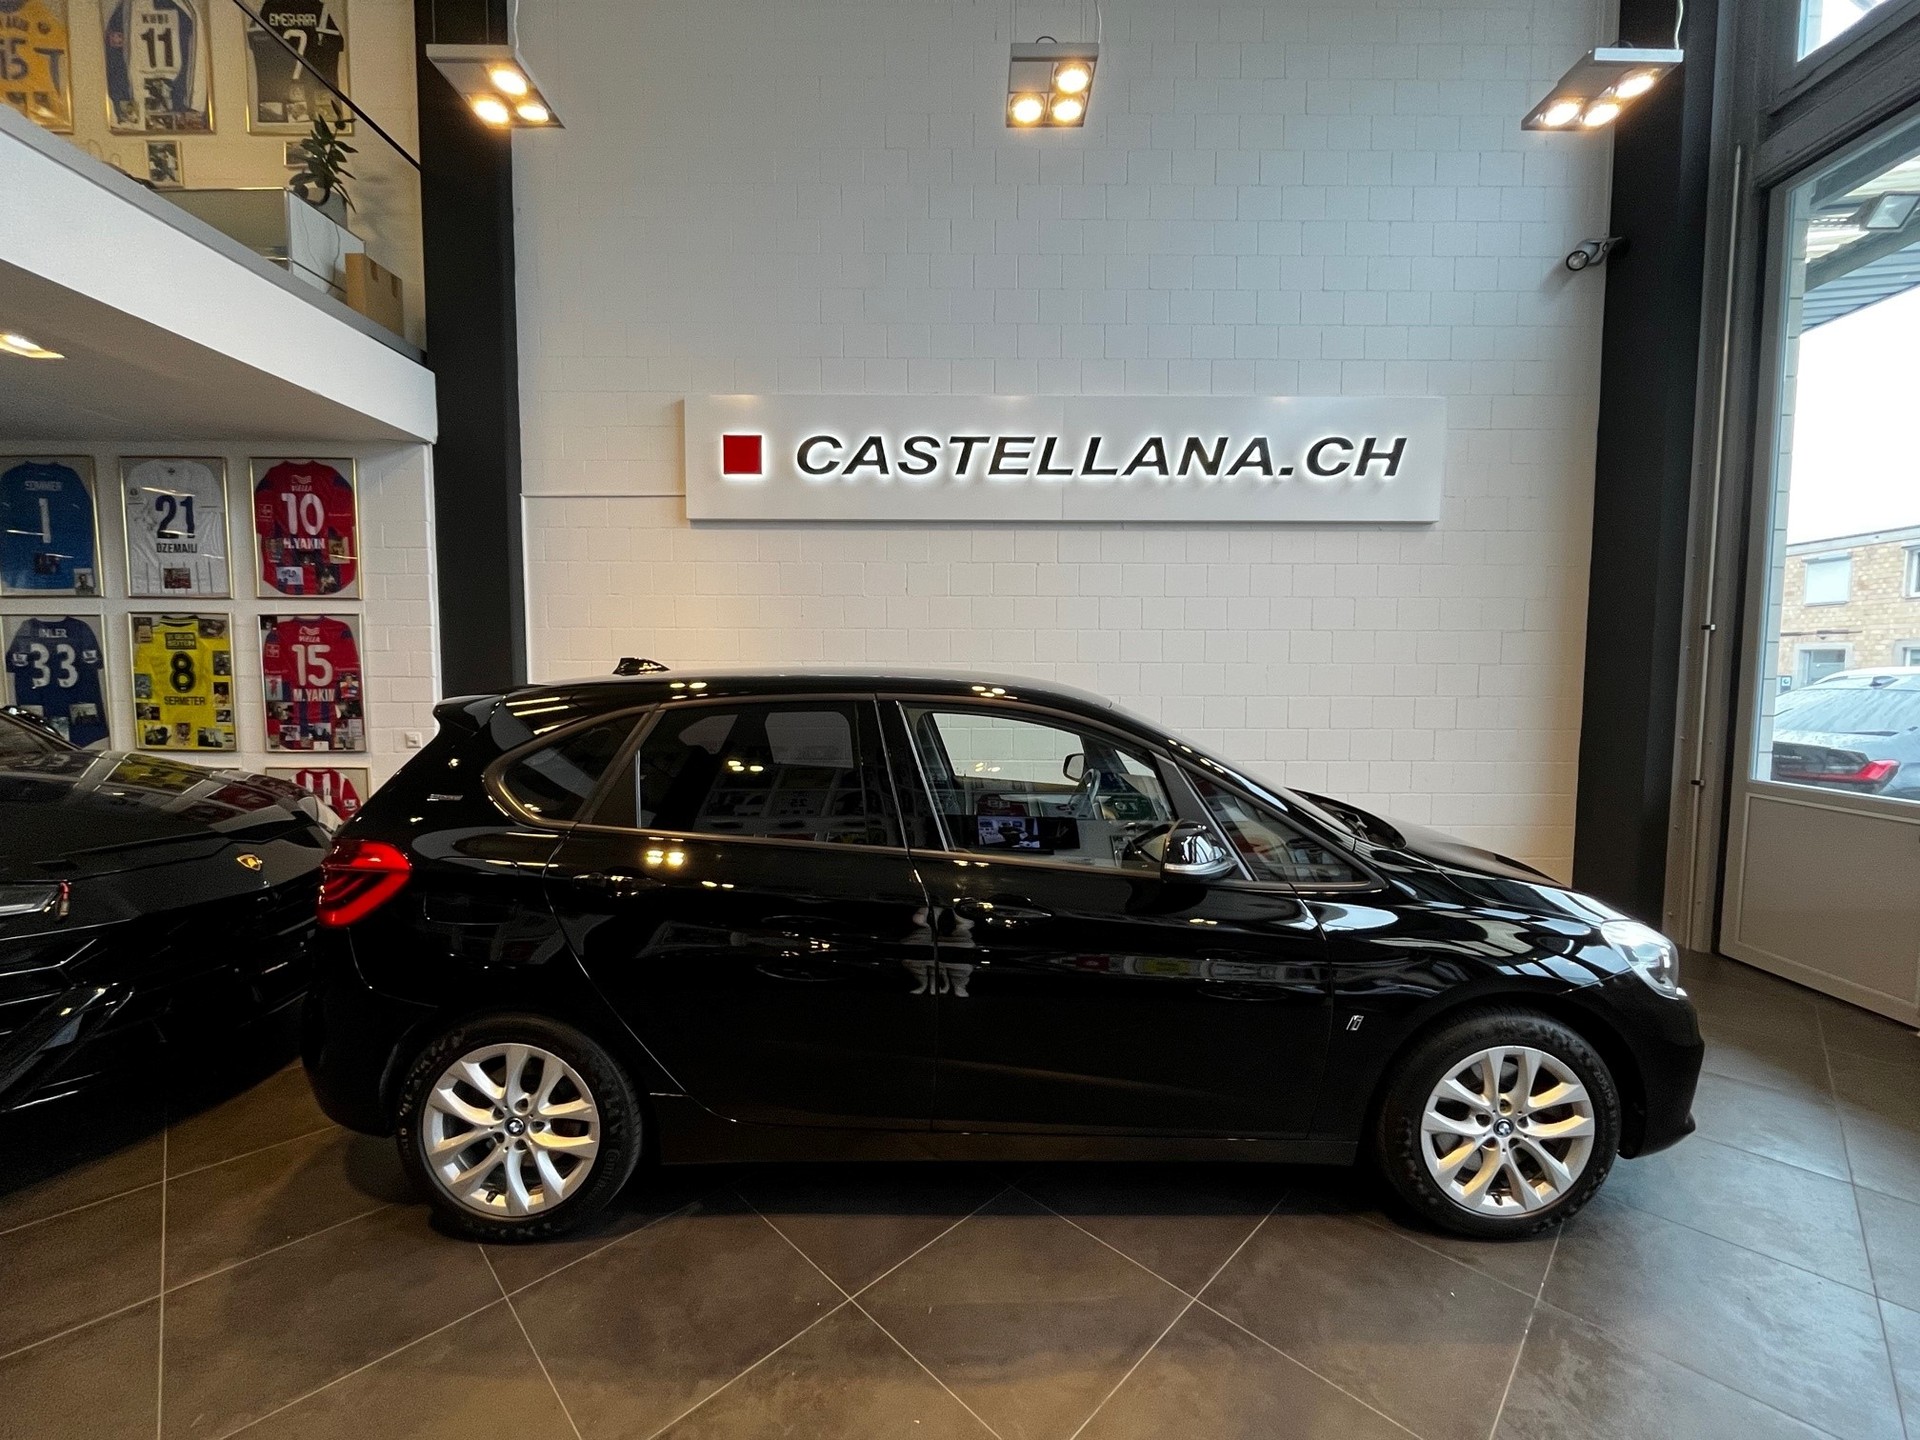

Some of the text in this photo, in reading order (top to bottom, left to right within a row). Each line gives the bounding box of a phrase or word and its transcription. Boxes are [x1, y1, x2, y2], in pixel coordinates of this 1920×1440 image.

[141, 27, 174, 69] 11
[283, 29, 307, 80] 7
[795, 434, 1408, 478] CASTELLANA.CH
[38, 497, 52, 544] 1
[155, 494, 196, 539] 21
[281, 492, 325, 536] 10
[29, 642, 79, 689] 33
[170, 650, 197, 694] 8
[291, 643, 334, 687] 15
